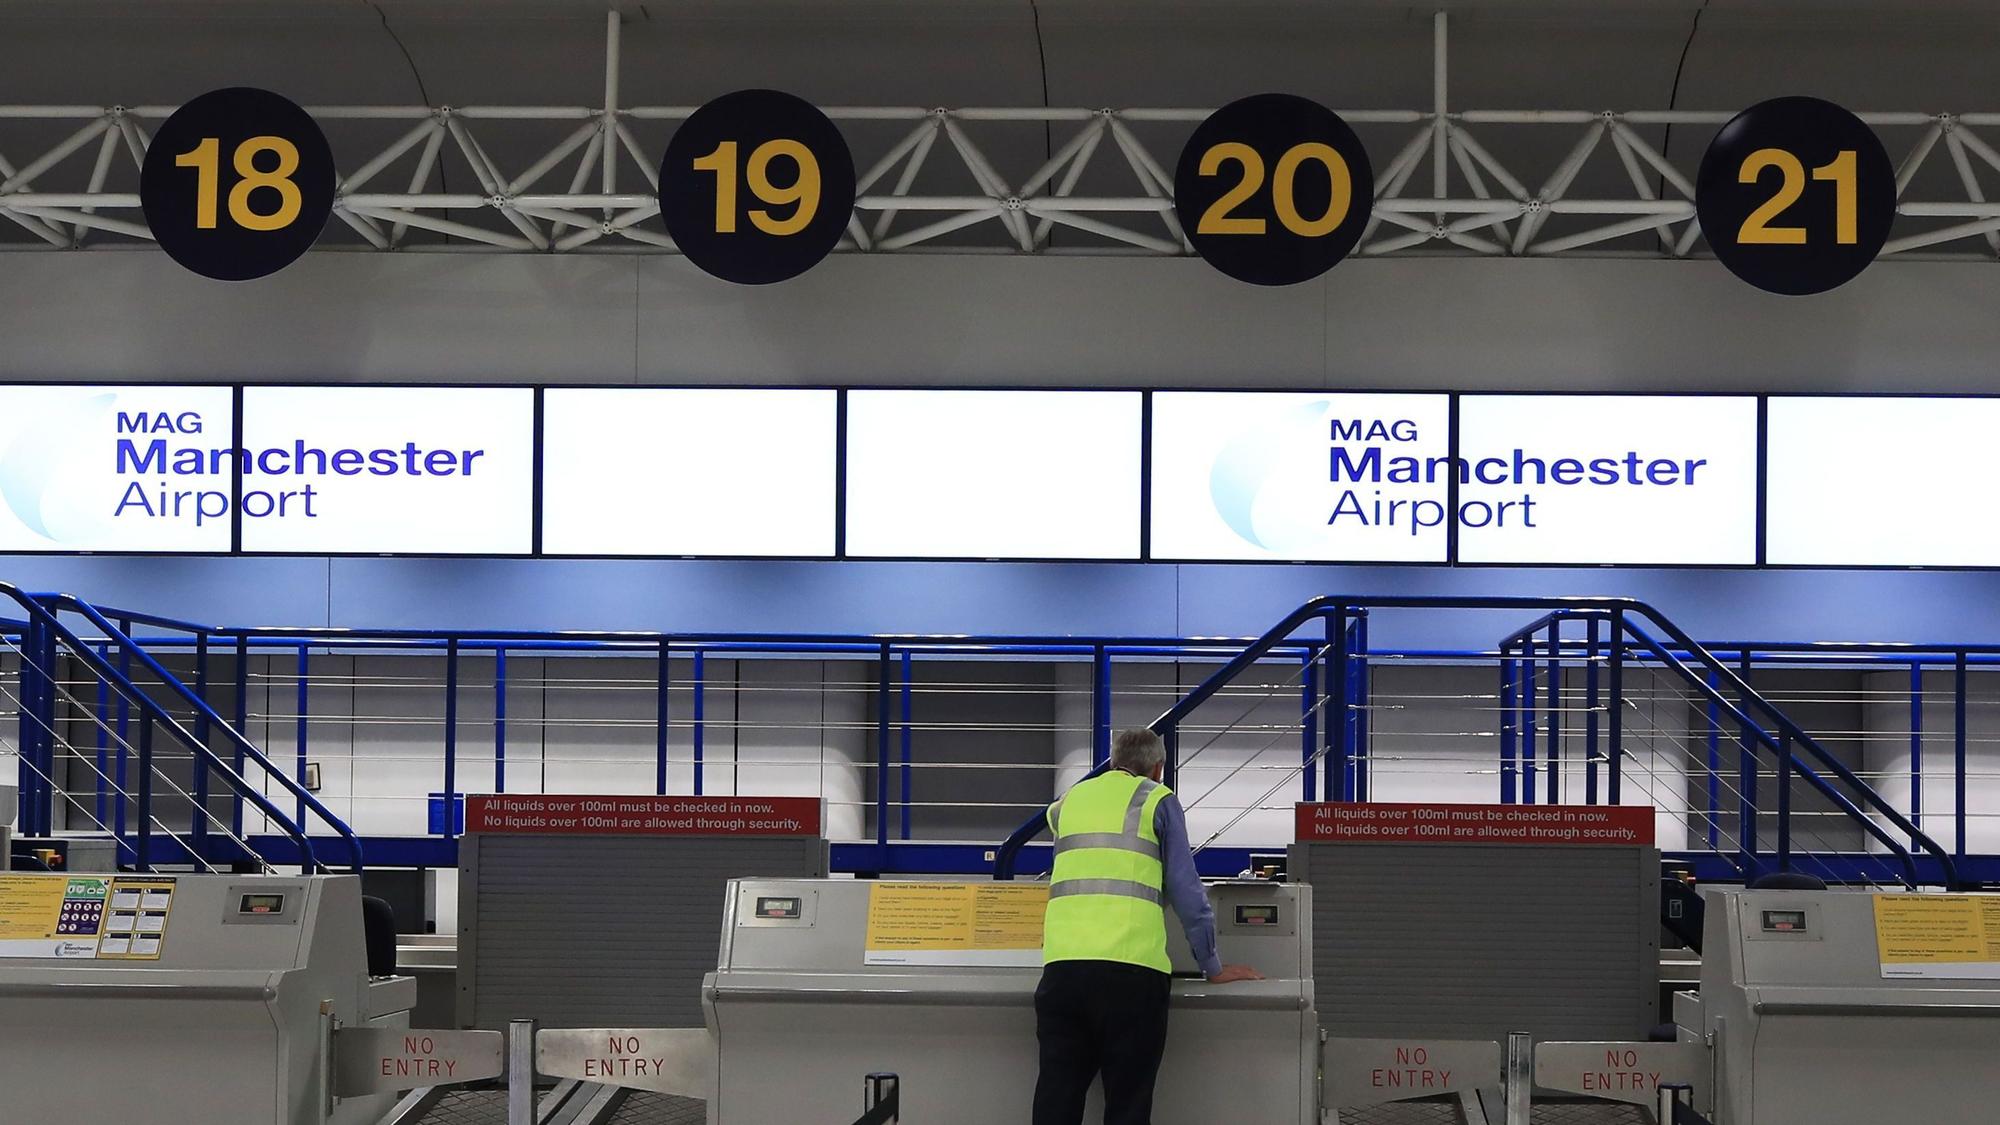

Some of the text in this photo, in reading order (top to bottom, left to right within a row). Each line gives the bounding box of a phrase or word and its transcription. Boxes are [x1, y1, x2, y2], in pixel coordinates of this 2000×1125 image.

[175, 136, 302, 231] 18
[693, 138, 821, 236] 19
[1198, 142, 1352, 238] 20
[1737, 149, 1858, 245] 21
[117, 411, 203, 434] MAG
[1330, 419, 1418, 442] MAG
[116, 439, 485, 476] Manchester
[1329, 447, 1708, 486] Manchester
[114, 481, 318, 526] Airport
[1327, 490, 1537, 536] Airport
[484, 799, 774, 814] All liquids over 100ml must be checked in now.
[1314, 807, 1609, 823] All liquids over 100ml must be checked in now.
[484, 815, 802, 832] No liquids over 100ml are allowed through security.
[1315, 823, 1637, 841] No liquids over 100ml are allowed through security.
[404, 1037, 434, 1055] NO
[609, 1036, 640, 1054] NO
[1396, 1047, 1428, 1065] NO
[1606, 1050, 1637, 1068] NO
[381, 1058, 457, 1077] ENTRY
[584, 1058, 665, 1077] ENTRY
[1371, 1069, 1452, 1088] ENTRY
[1582, 1071, 1661, 1090] ENTRY
